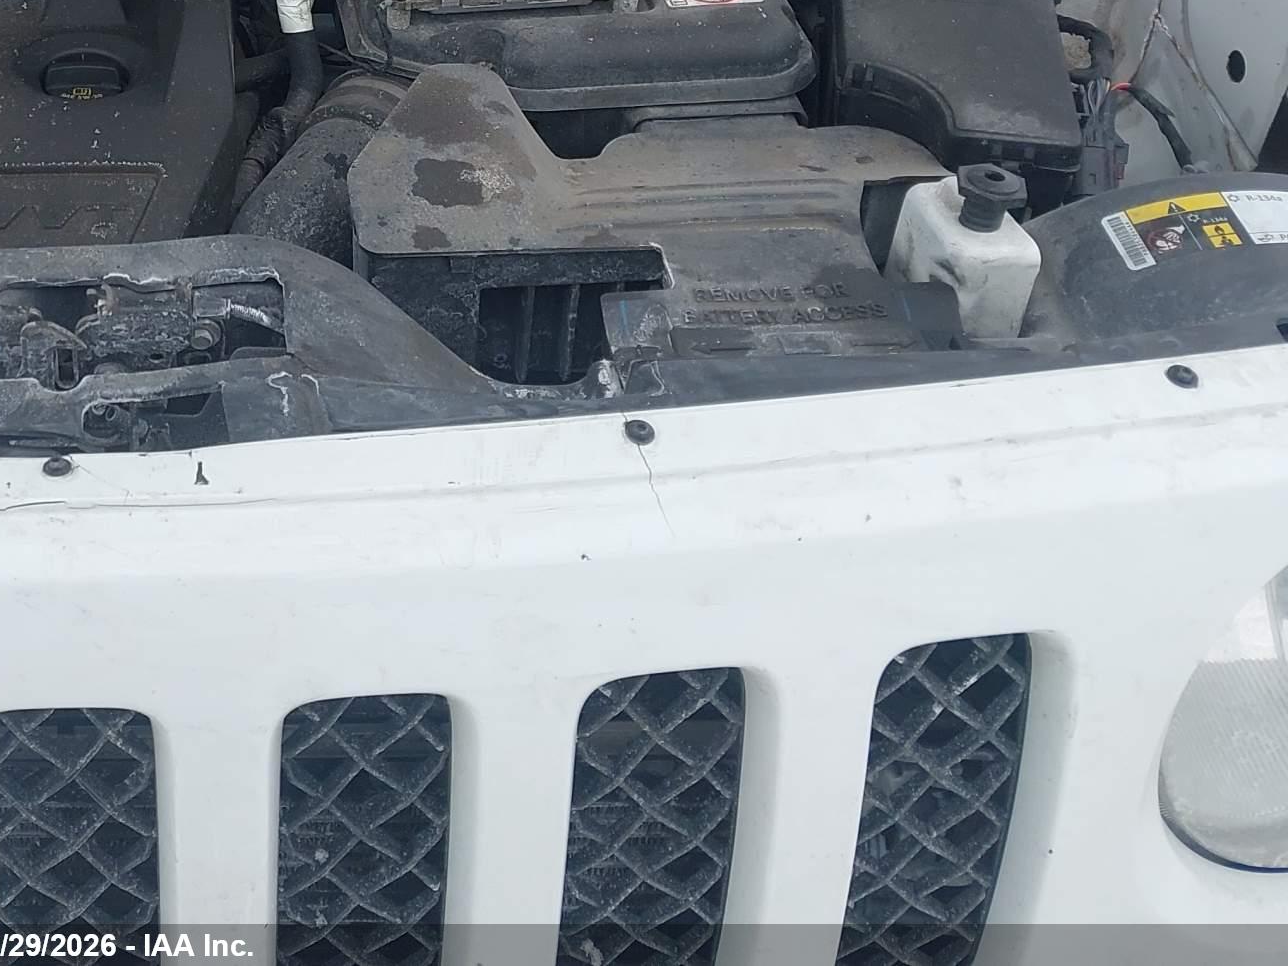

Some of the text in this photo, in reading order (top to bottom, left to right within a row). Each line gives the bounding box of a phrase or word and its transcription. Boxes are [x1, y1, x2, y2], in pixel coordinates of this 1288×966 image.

[693, 282, 850, 303] REMOVE FOR
[682, 303, 888, 325] BATTERY ACCESS
